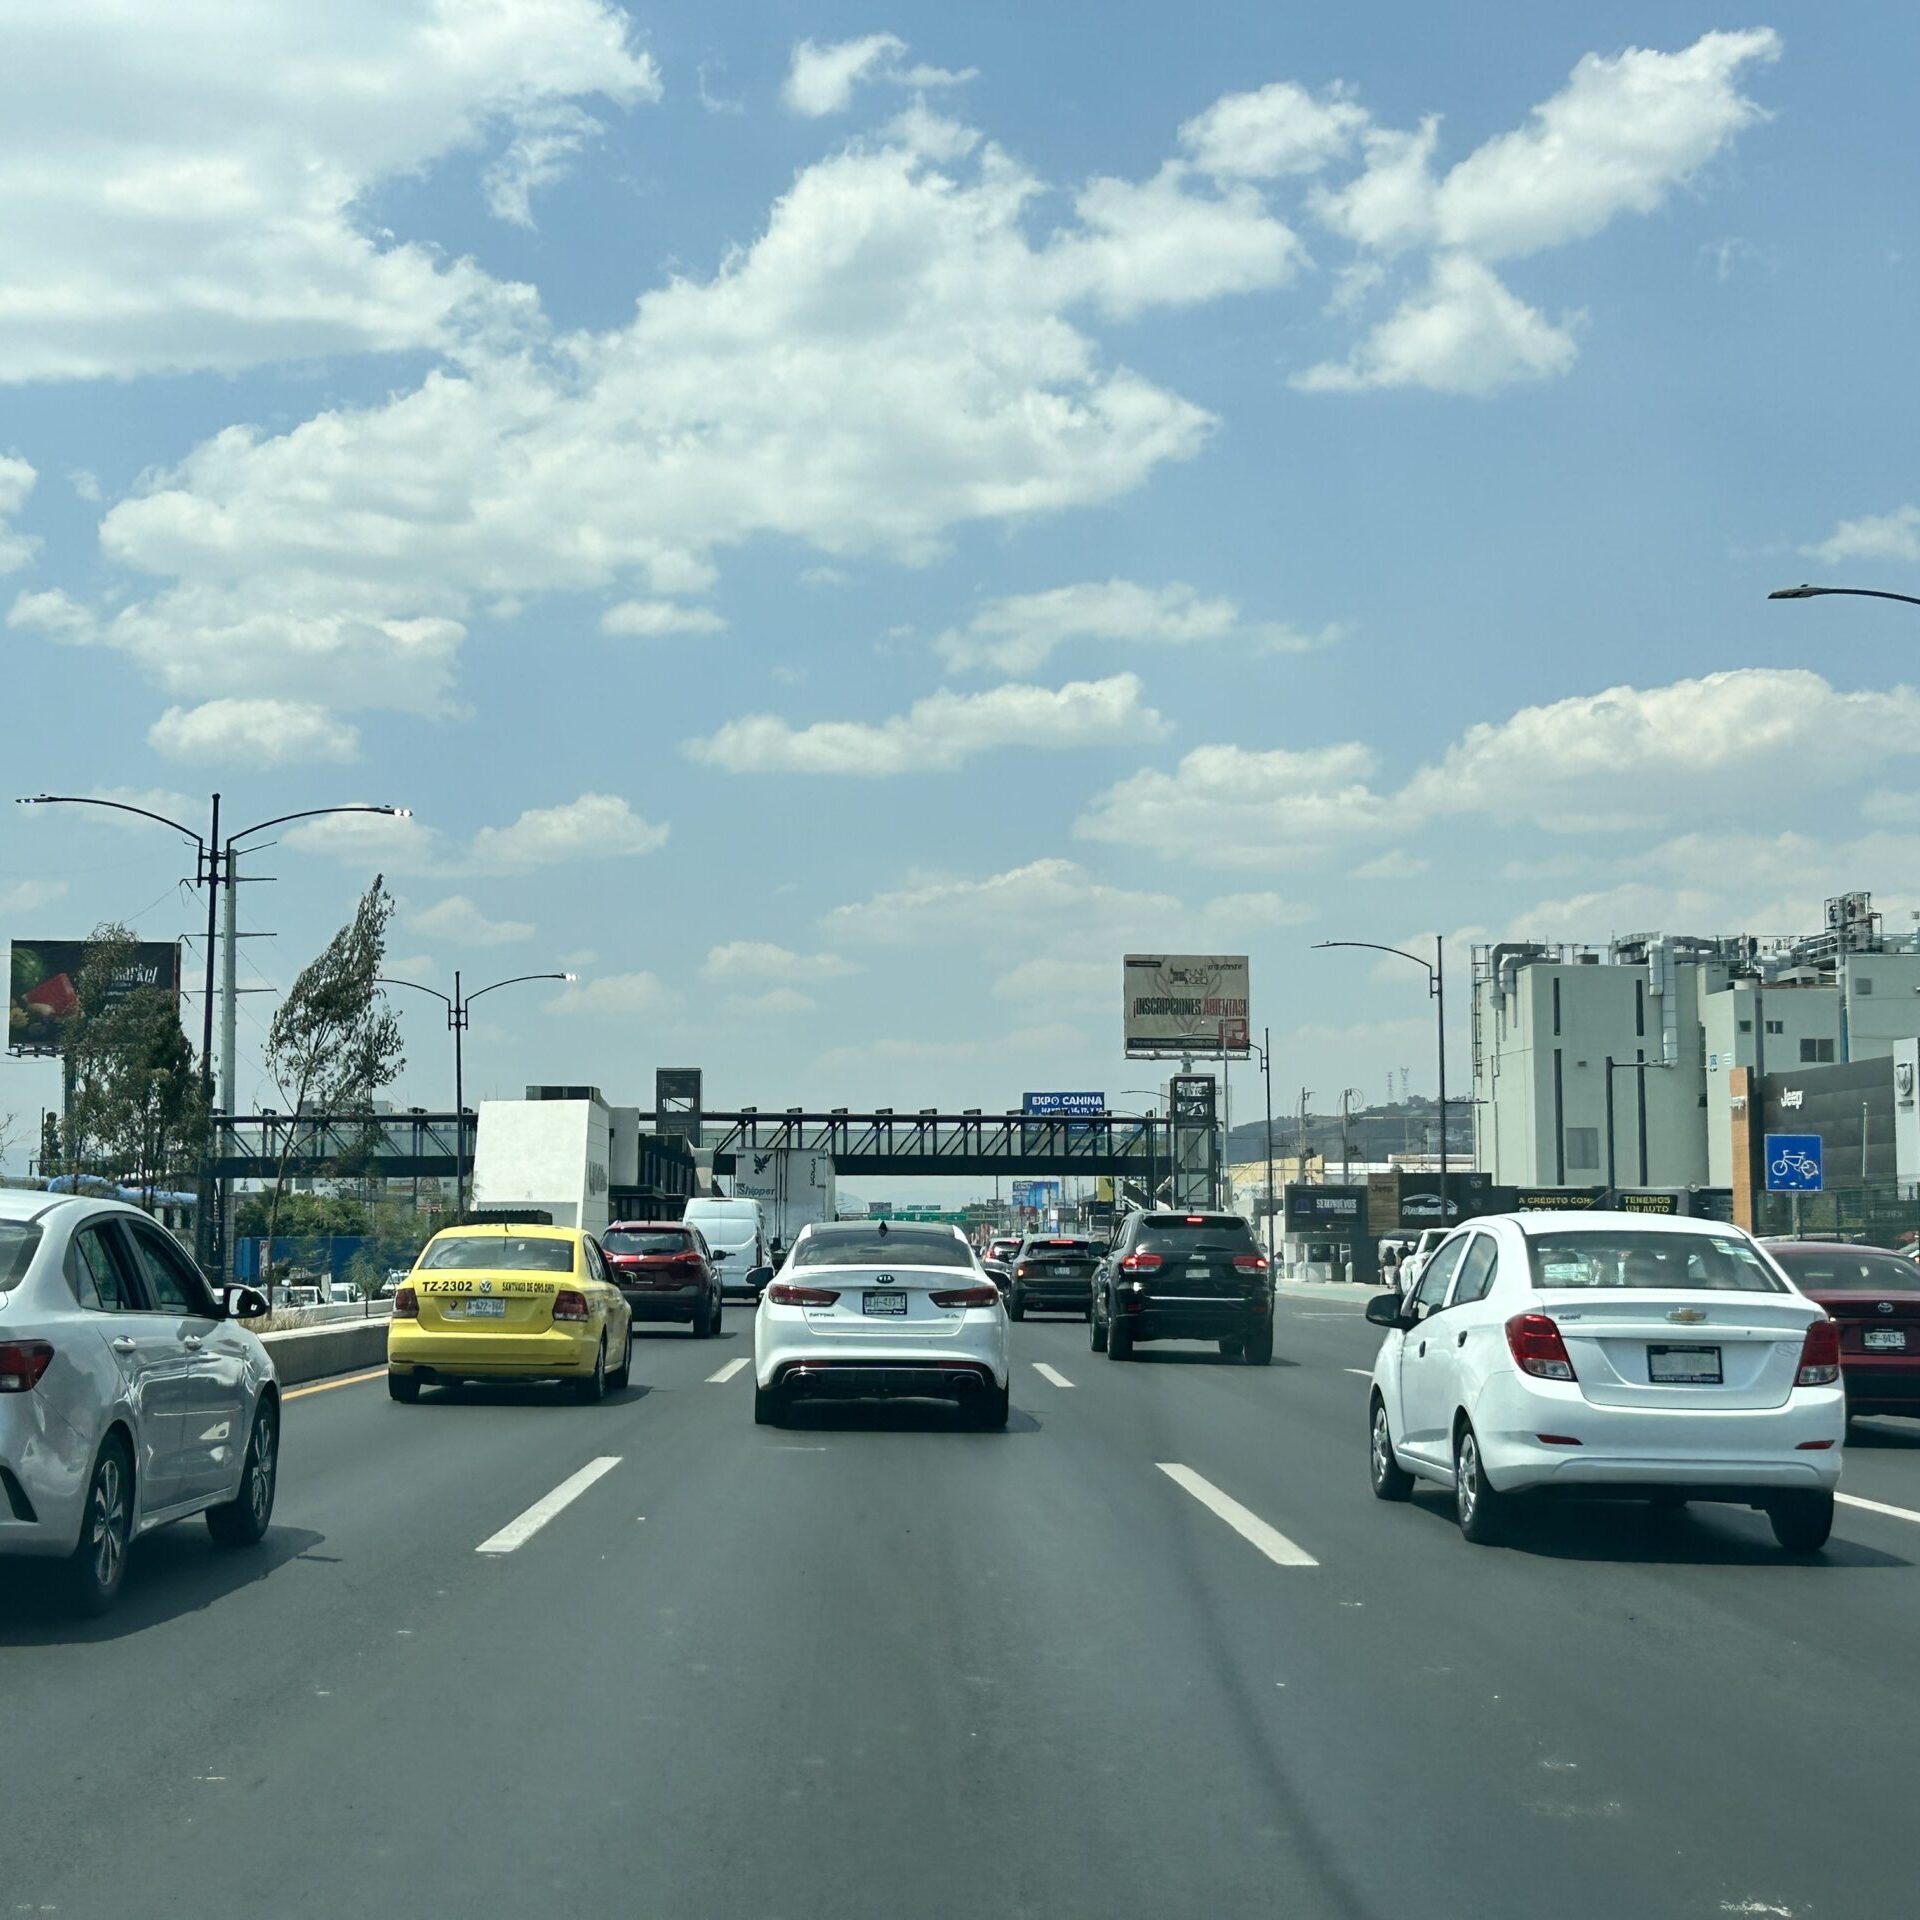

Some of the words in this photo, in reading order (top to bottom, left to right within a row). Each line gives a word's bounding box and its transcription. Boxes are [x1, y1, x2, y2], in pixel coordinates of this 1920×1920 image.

[1032, 1096, 1060, 1106] EXPO
[1062, 1096, 1103, 1105] CANINA
[1781, 1087, 1803, 1109] Jeep
[736, 1186, 776, 1198] Shipper
[1518, 1196, 1526, 1204] A
[1623, 1196, 1671, 1204] TENEMOS
[1642, 1205, 1670, 1214] AUTO
[1189, 1253, 1207, 1262] Jeep
[422, 1280, 473, 1292] TZ-2302
